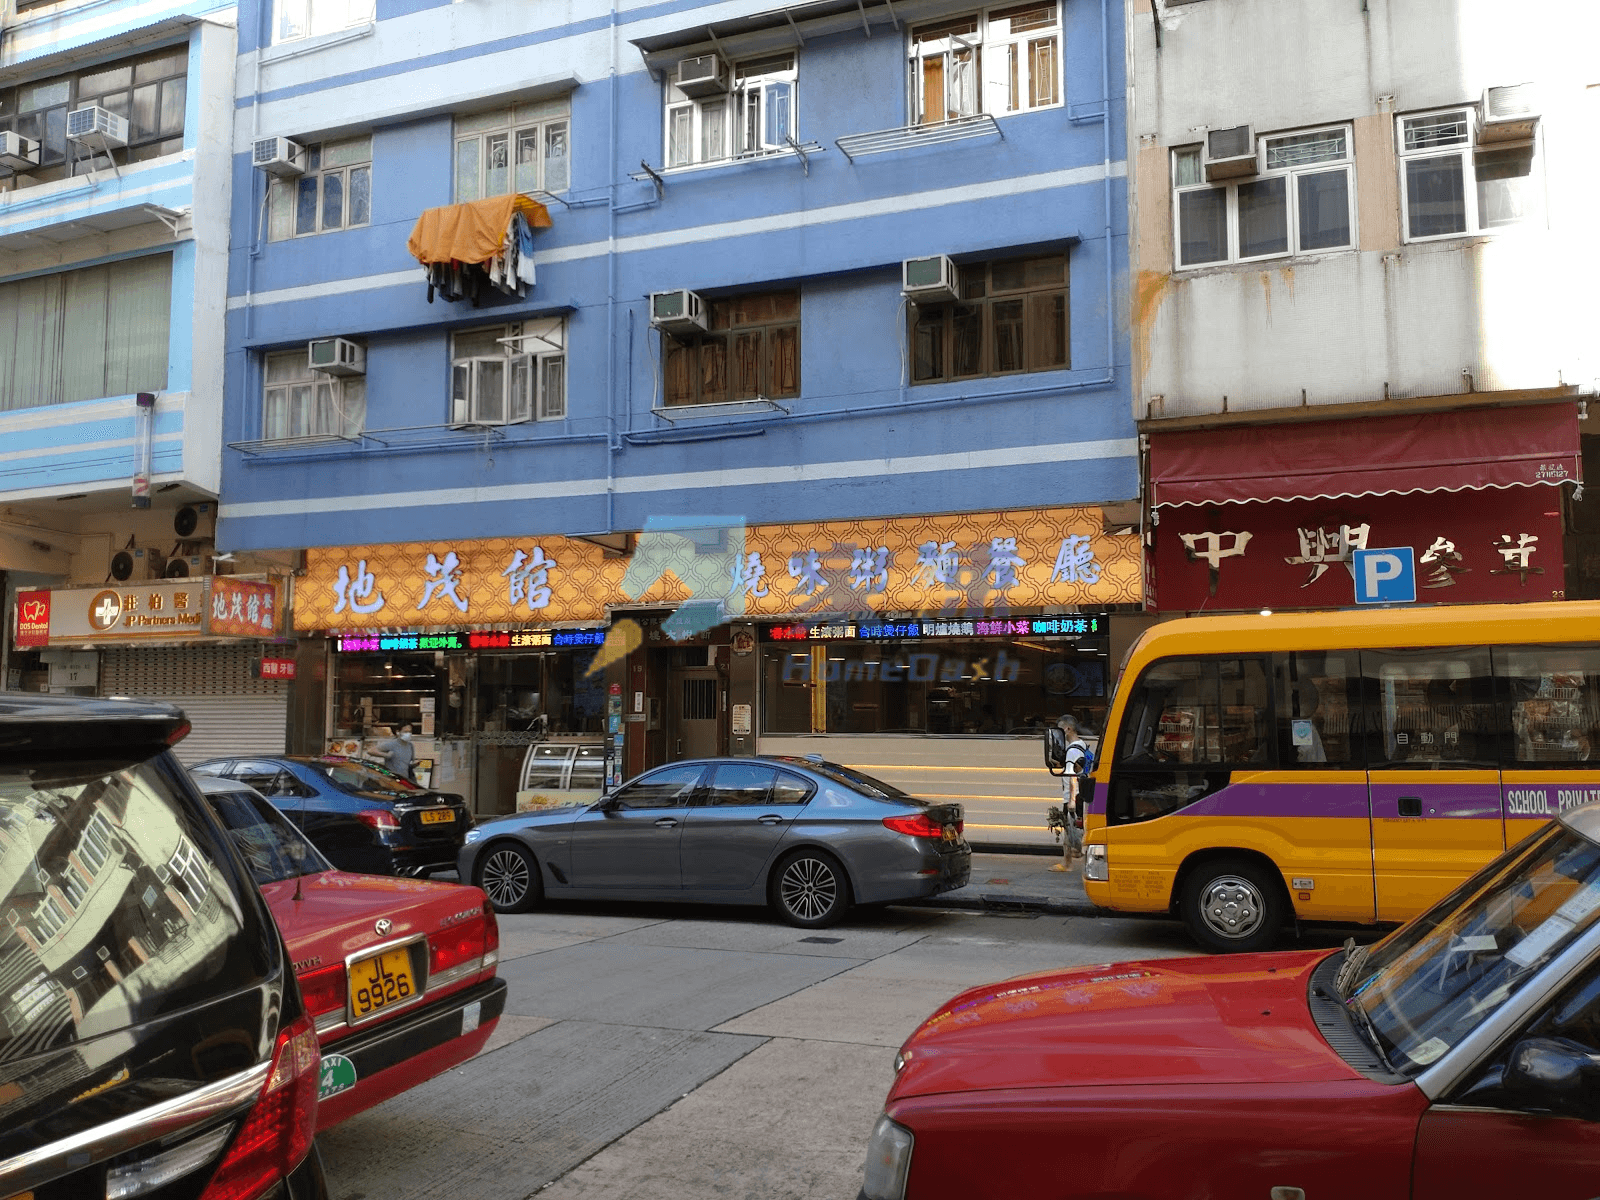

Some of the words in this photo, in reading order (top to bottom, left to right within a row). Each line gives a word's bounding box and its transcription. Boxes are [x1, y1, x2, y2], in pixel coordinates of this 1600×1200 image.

[333, 545, 557, 614] 地茂館
[1364, 553, 1403, 598] P
[1551, 590, 1565, 598] 23
[213, 592, 260, 624] 地茂館
[31, 622, 48, 630] Dental
[138, 615, 176, 626] Partners
[70, 672, 78, 680] 17
[1397, 731, 1457, 744] 自動門
[1508, 790, 1552, 814] SCHOOL
[369, 957, 393, 983] JL
[357, 973, 410, 1013] 9926
[321, 1057, 342, 1071] AXI
[322, 1069, 334, 1087] 4
